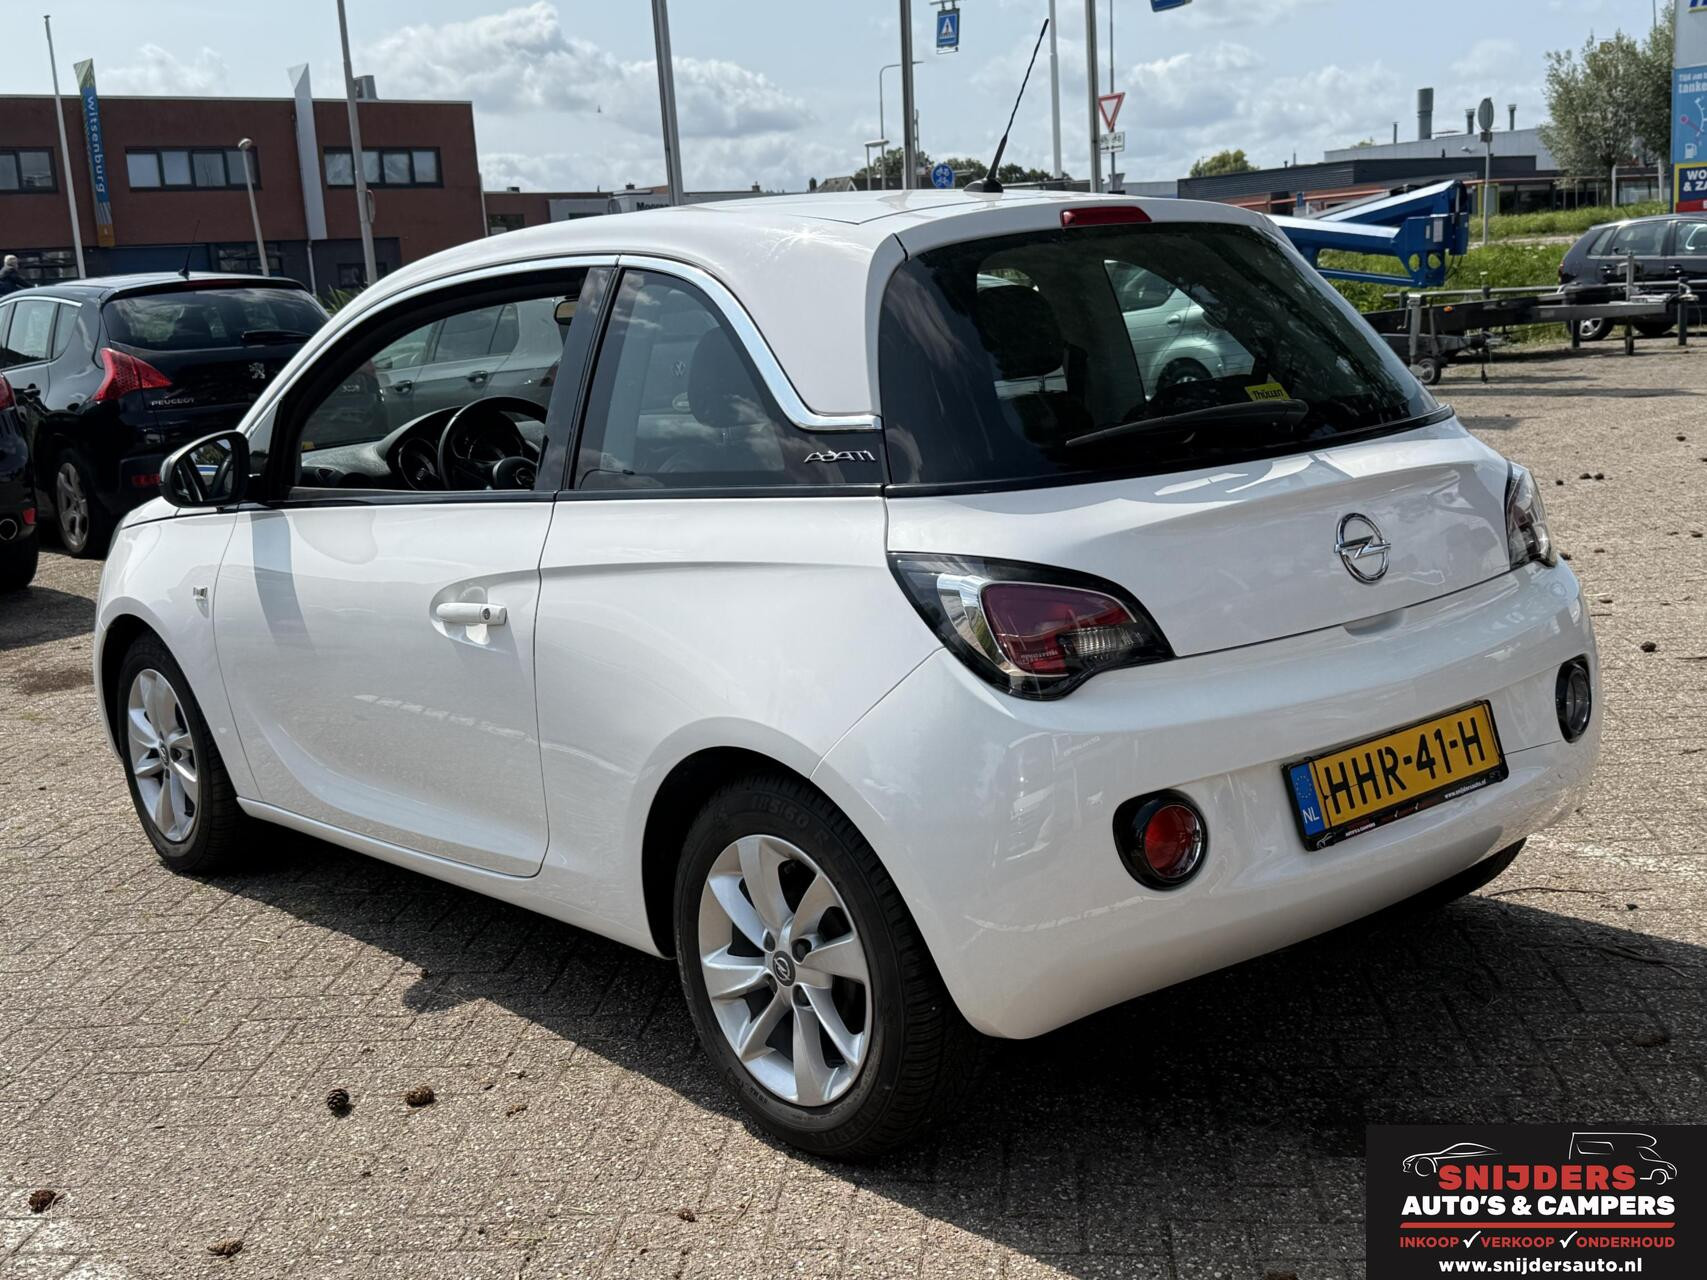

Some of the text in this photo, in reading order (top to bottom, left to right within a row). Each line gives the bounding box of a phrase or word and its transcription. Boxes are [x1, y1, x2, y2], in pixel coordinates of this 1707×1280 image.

[87, 96, 106, 193] witsenburg
[1683, 181, 1692, 192] &
[151, 398, 194, 406] PEUGEOT
[803, 449, 876, 463] ADAM
[1324, 717, 1485, 814] HHR-41-H
[1303, 806, 1319, 824] NL
